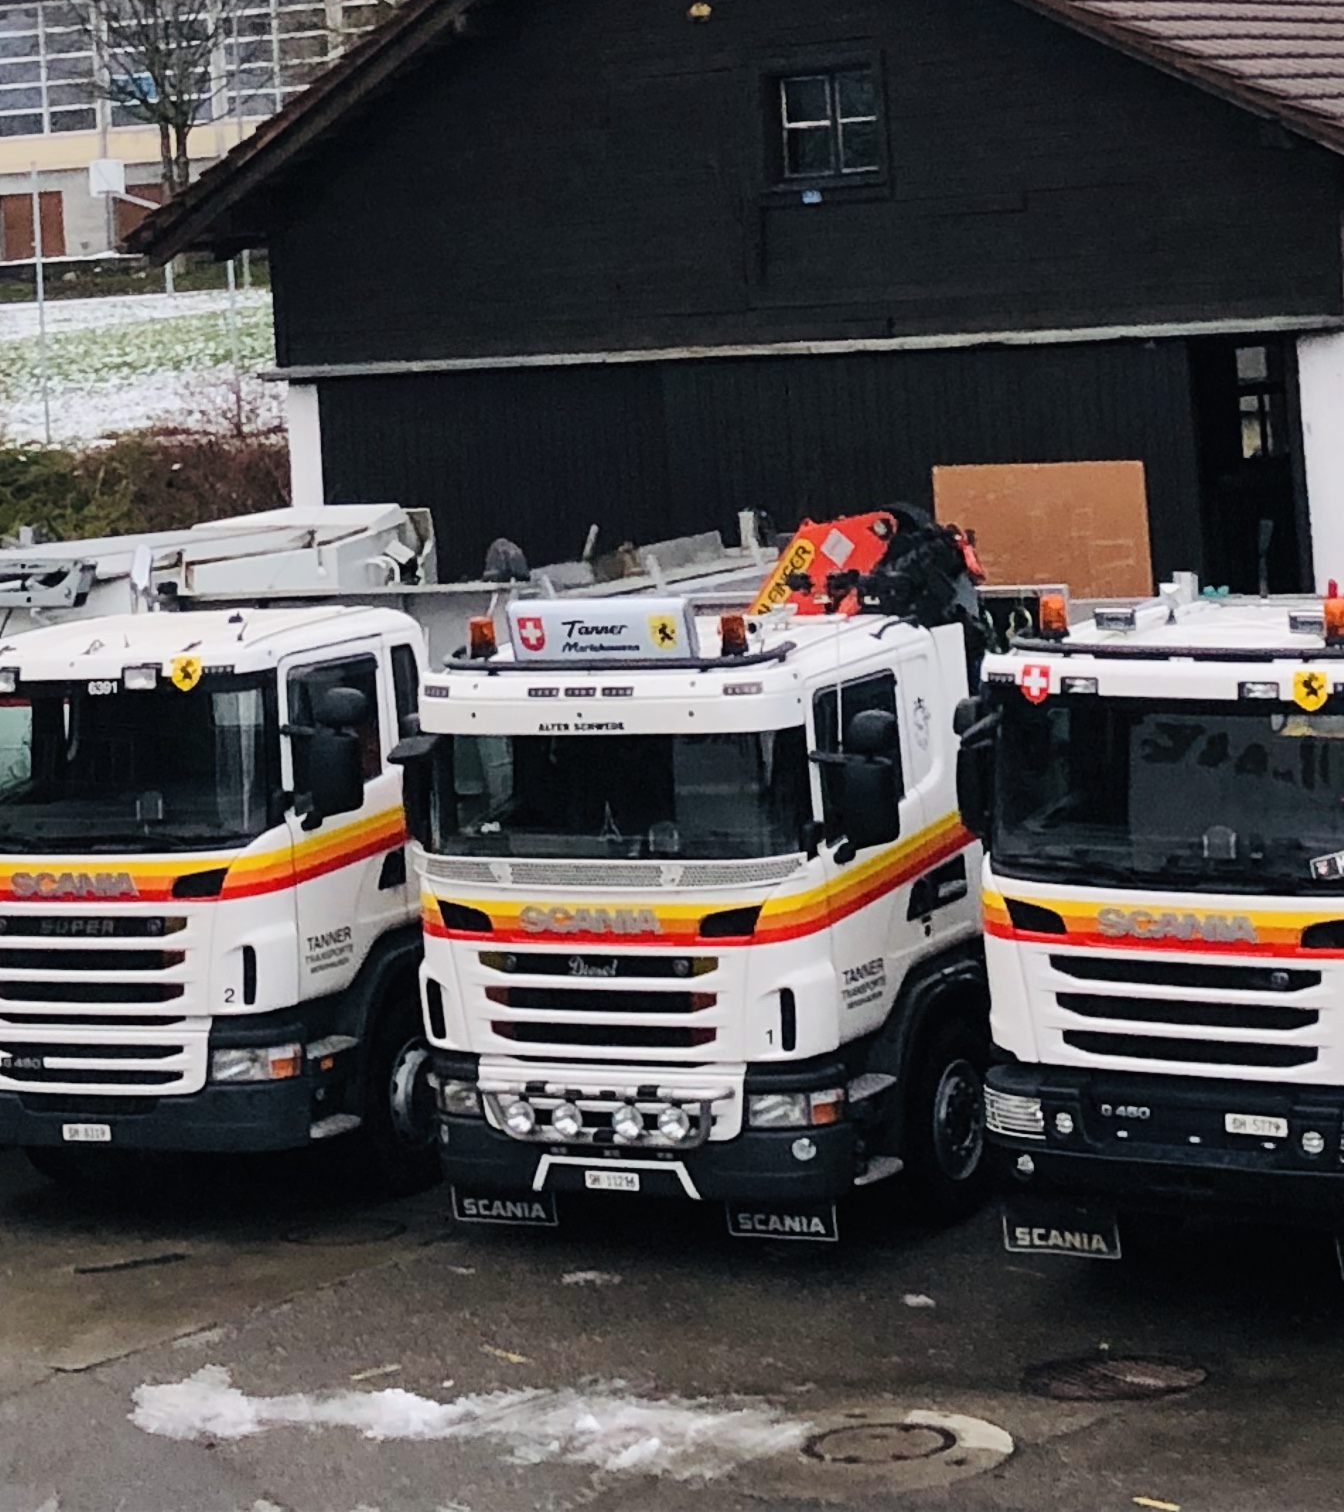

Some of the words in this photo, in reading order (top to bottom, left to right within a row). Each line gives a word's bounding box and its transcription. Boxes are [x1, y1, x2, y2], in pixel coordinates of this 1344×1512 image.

[561, 620, 628, 638] Tanner
[538, 722, 570, 732] ALTER
[11, 872, 140, 897] SCANIA
[41, 919, 114, 935] SUPER
[519, 906, 663, 935] SCANIA
[1097, 908, 1258, 944] SCANIA
[306, 926, 352, 952] TANNER
[841, 957, 884, 985] TANNER
[224, 987, 236, 1004] 2
[765, 1029, 773, 1045] 1
[463, 1198, 547, 1220] SCANIA
[737, 1212, 827, 1235] SCANIA
[1015, 1226, 1109, 1253] SCANIA
